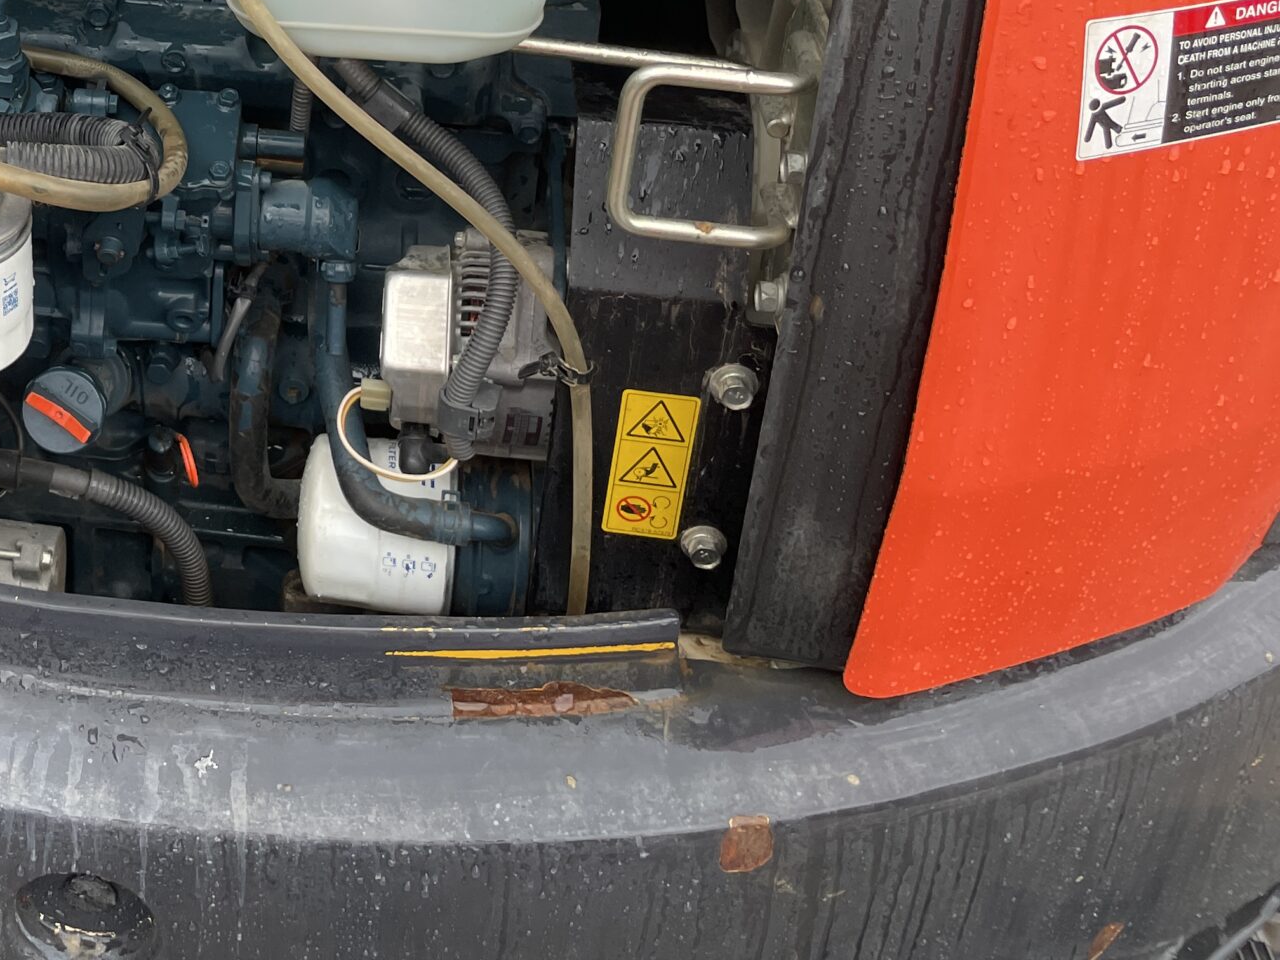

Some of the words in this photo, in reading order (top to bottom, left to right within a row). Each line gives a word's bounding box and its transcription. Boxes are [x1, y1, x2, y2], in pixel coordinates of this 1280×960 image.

[1235, 1, 1280, 20] DANG
[1179, 40, 1191, 51] TO
[1192, 36, 1218, 48] AVOID
[1219, 28, 1263, 44] PERSONAL
[1177, 52, 1206, 65] DEATH
[1207, 47, 1231, 59] FROM
[1232, 45, 1239, 54] A
[1240, 38, 1276, 53] MACHINE
[1177, 72, 1186, 81] 1.
[1190, 69, 1204, 79] Do
[1207, 65, 1223, 75] not
[1225, 61, 1247, 72] start
[1248, 55, 1280, 67] engine
[1188, 79, 1228, 92] shorting
[1230, 71, 1262, 84] across
[1171, 113, 1181, 122] 2.
[1185, 108, 1209, 119] Start
[1211, 101, 1244, 115] engine
[1246, 97, 1266, 107] only
[1187, 91, 1234, 106] terminals.
[1183, 116, 1233, 133] operator's
[1234, 112, 1257, 122] seat.
[65, 379, 89, 405] OIL
